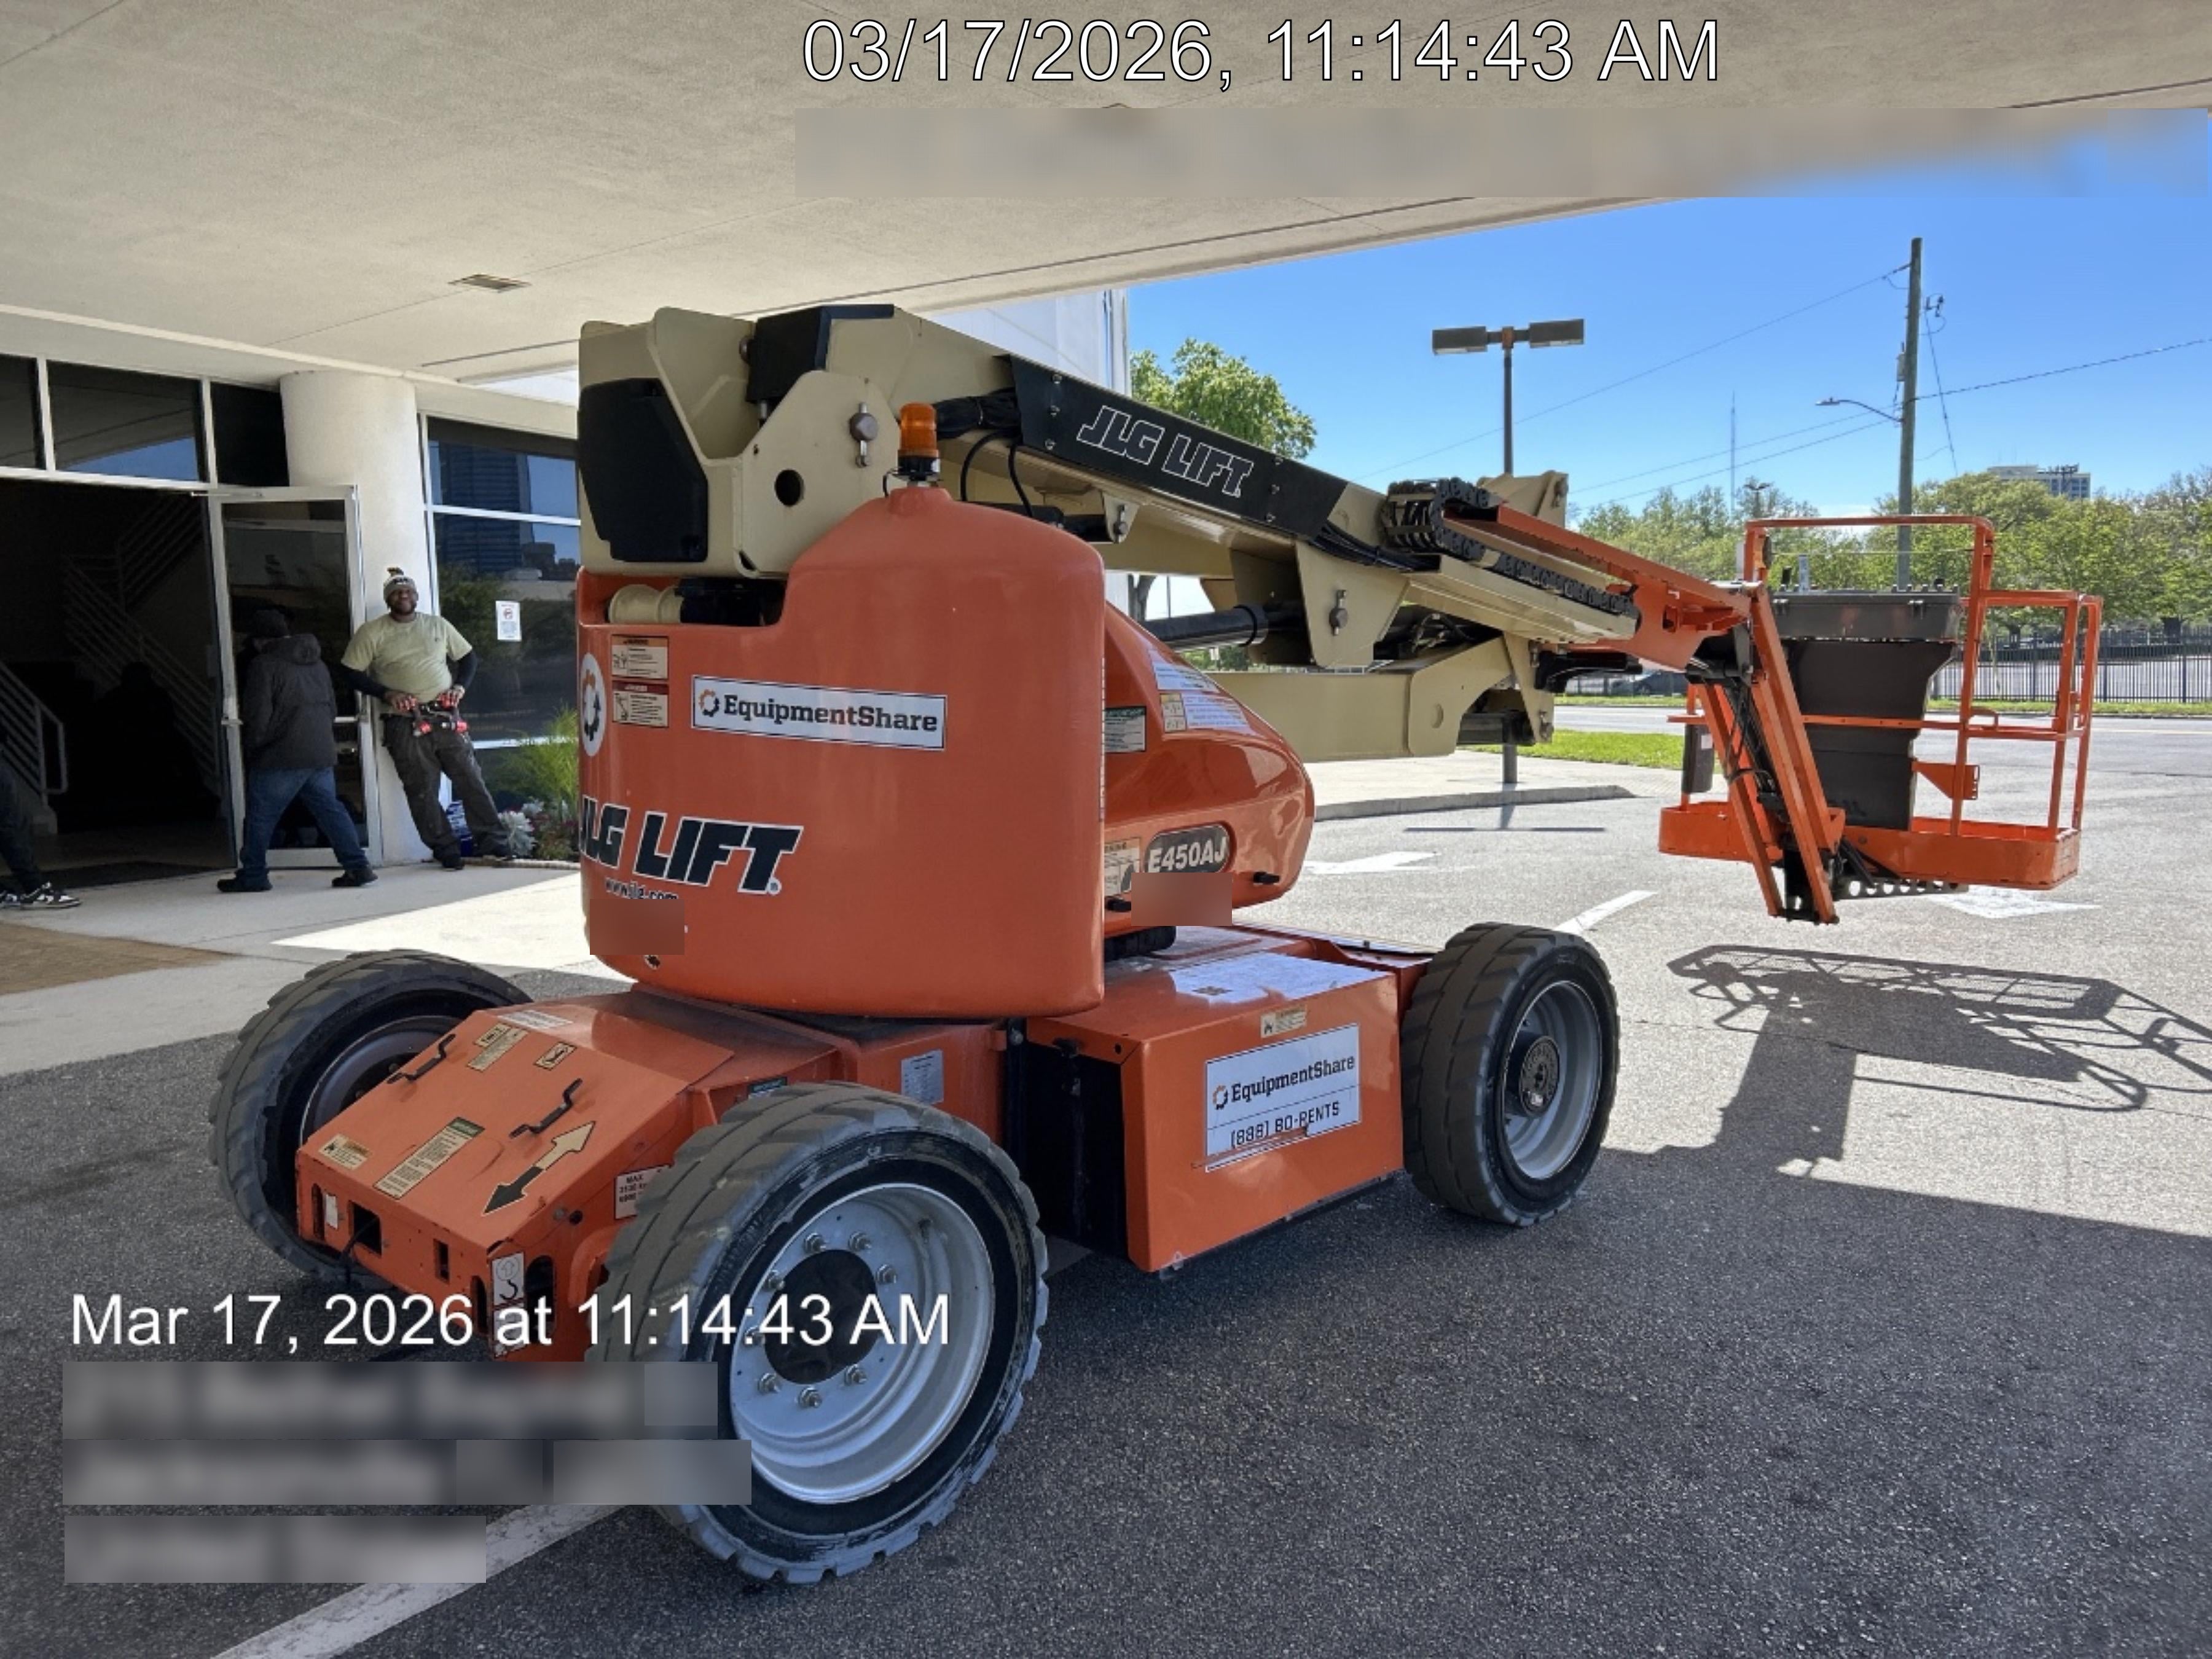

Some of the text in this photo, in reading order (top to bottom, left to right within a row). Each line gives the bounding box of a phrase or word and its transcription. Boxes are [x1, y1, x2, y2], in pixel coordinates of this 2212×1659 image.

[1077, 405, 1254, 498] JLG LIFT
[724, 694, 938, 732] EquipmentShare
[632, 810, 804, 895] LIFT
[1147, 836, 1228, 873] E450AJ
[1231, 1056, 1355, 1104] EquipmentShare
